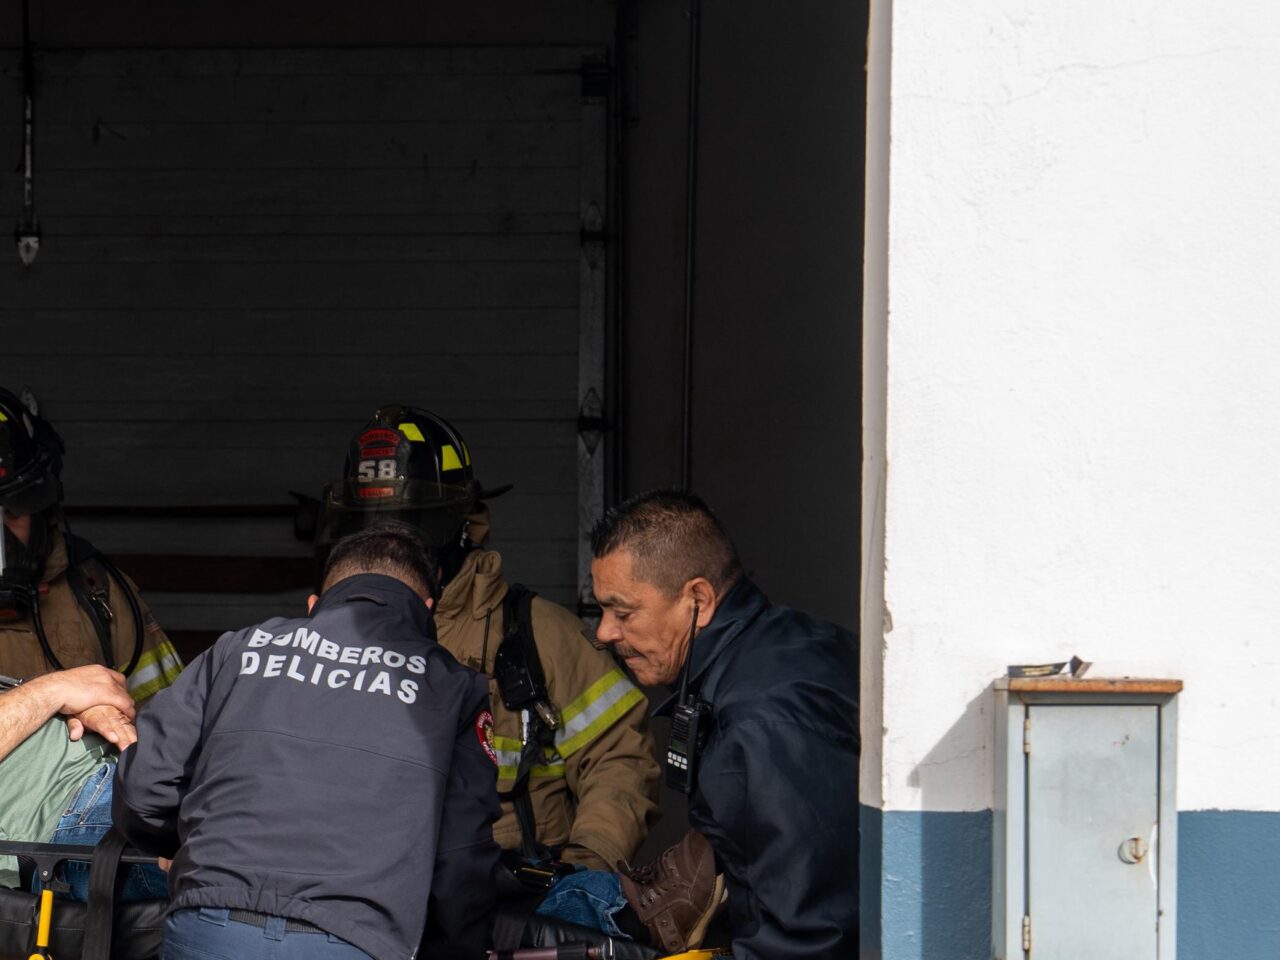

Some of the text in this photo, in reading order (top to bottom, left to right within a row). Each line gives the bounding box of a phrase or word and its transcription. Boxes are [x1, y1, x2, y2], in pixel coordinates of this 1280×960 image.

[358, 459, 397, 482] 58
[247, 627, 427, 675] BOMBEROS
[239, 650, 420, 705] DELICIAS
